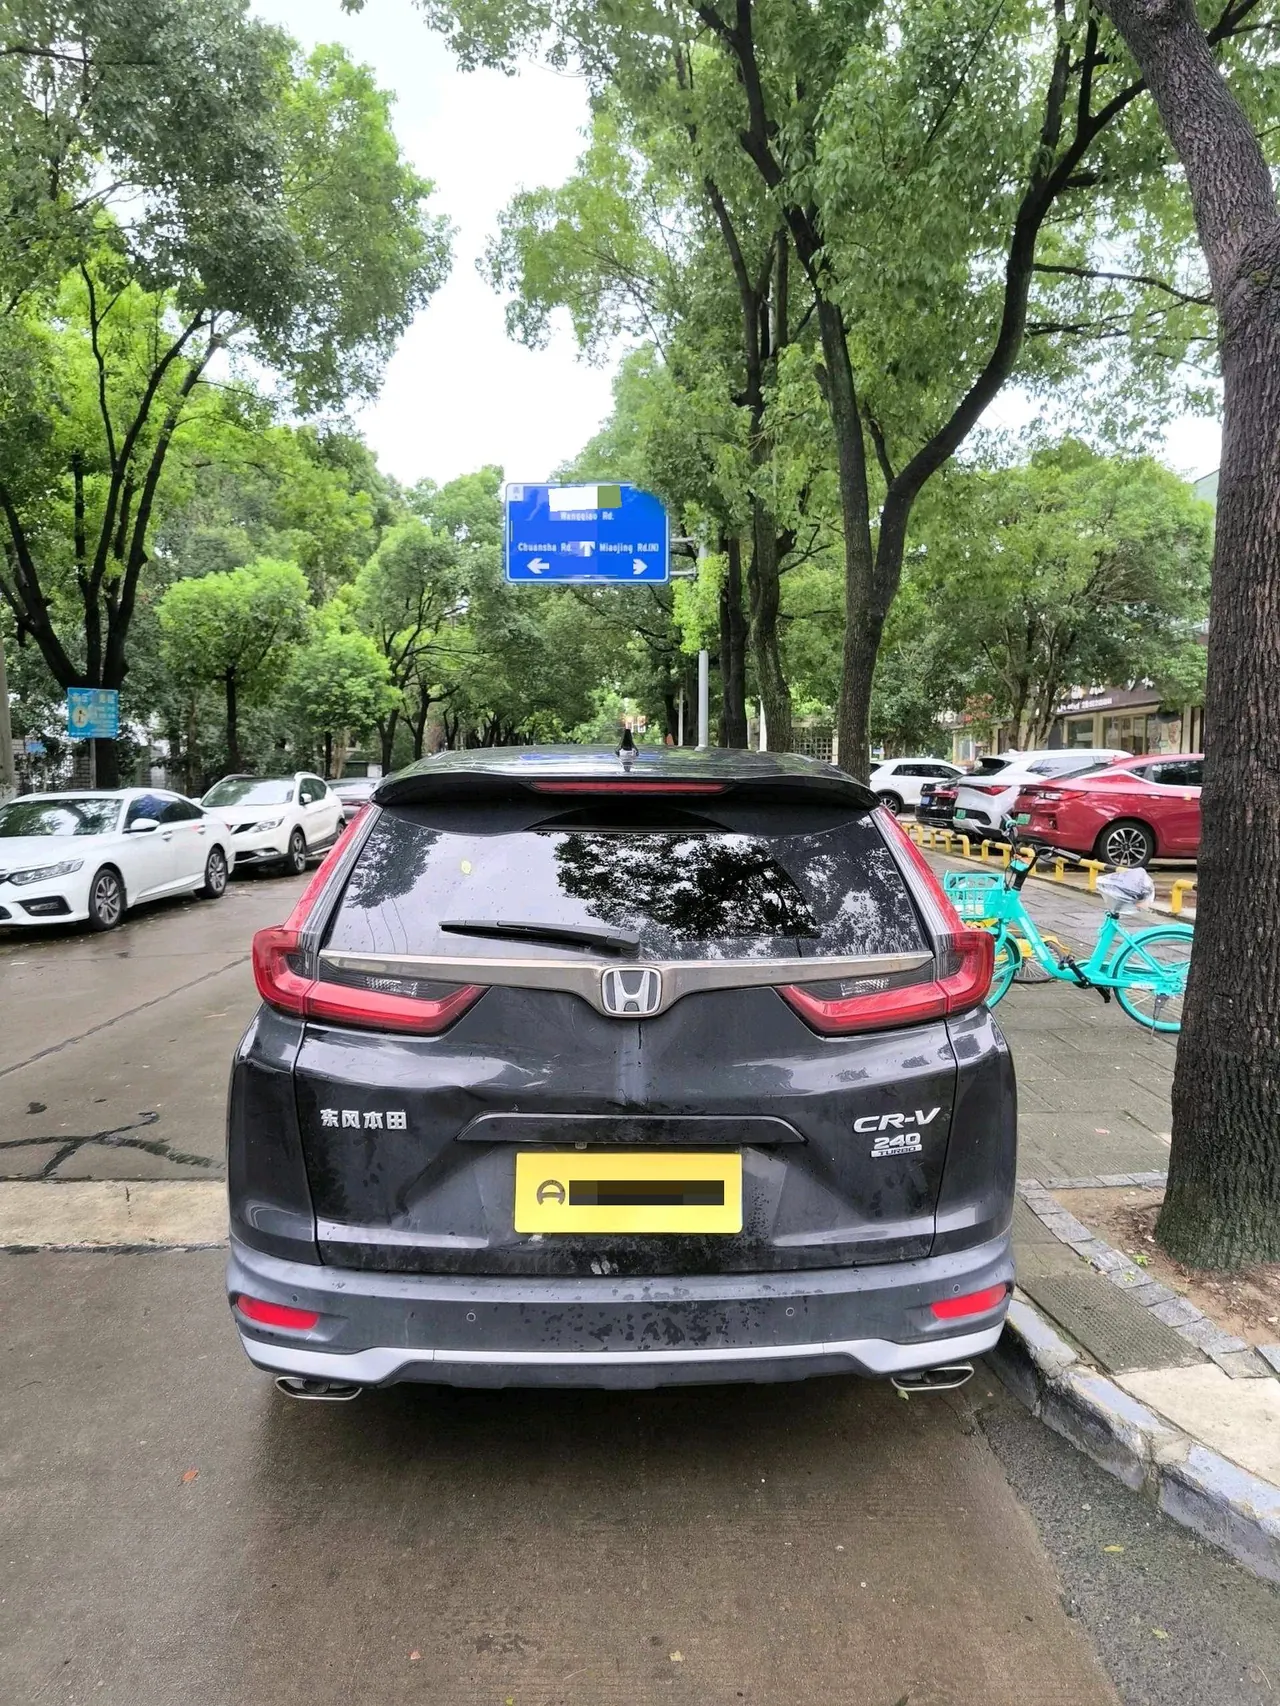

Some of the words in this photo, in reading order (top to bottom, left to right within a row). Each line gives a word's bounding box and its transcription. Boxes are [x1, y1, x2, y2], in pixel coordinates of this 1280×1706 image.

[602, 511, 615, 521] Rd.
[517, 542, 557, 552] Chuansha
[599, 543, 633, 554] Miaojing
[320, 1108, 408, 1130] 东风本田
[853, 1107, 941, 1133] CR-V
[874, 1132, 921, 1150] 240
[876, 1145, 918, 1157] TURBO
